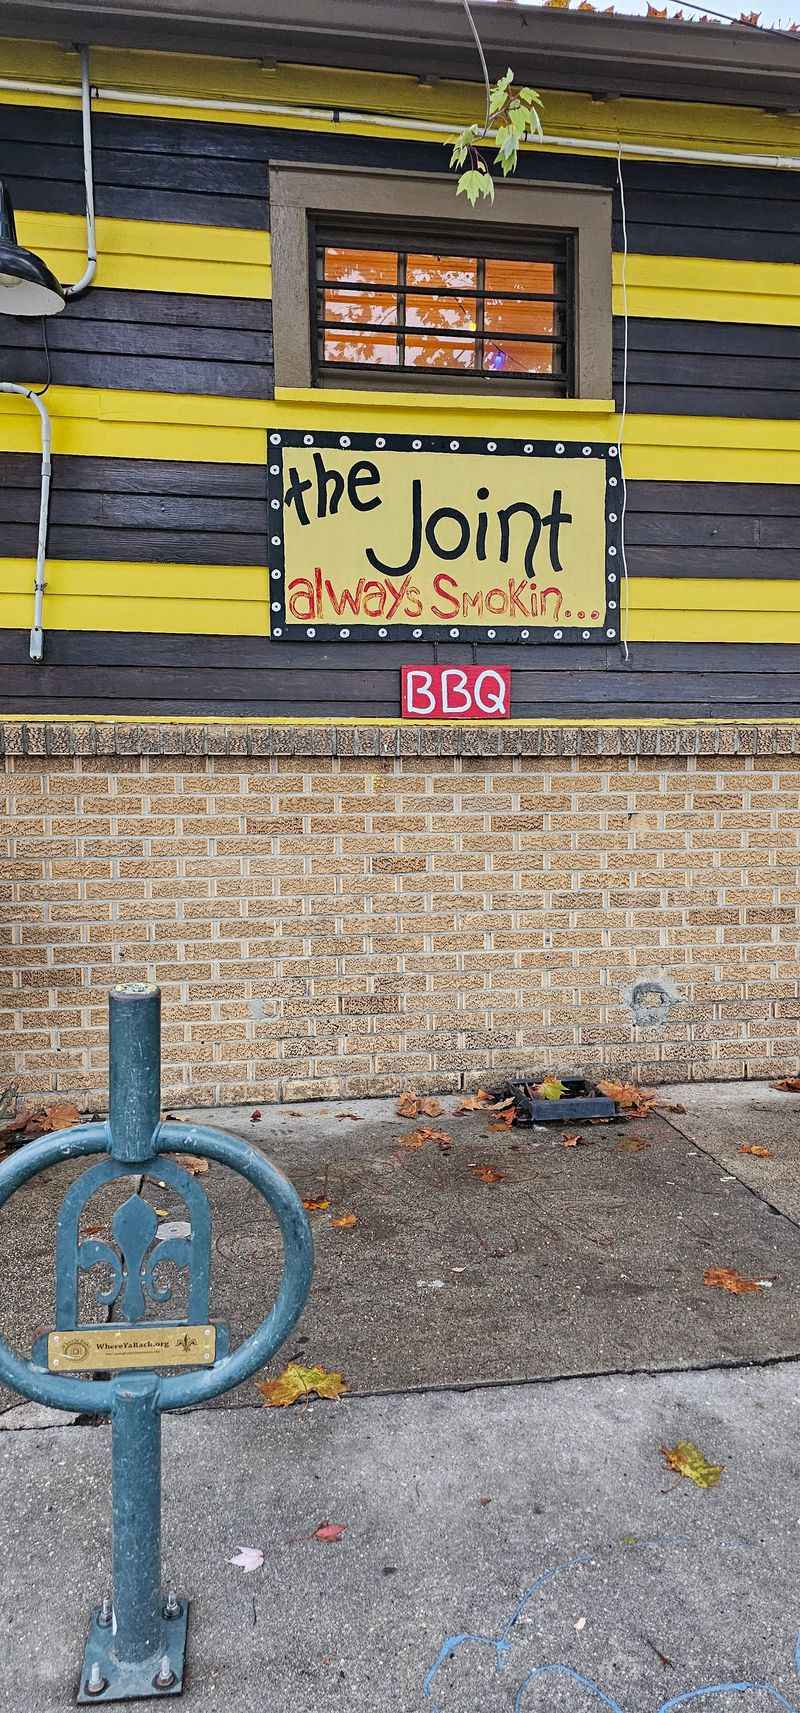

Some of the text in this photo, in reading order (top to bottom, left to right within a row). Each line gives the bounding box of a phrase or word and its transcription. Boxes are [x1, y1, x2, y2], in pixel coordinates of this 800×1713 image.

[284, 452, 383, 526] the
[365, 479, 573, 578] Joint
[288, 567, 423, 620] always
[406, 669, 506, 715] BBQ
[96, 1340, 170, 1351] WhereYaRack.org
